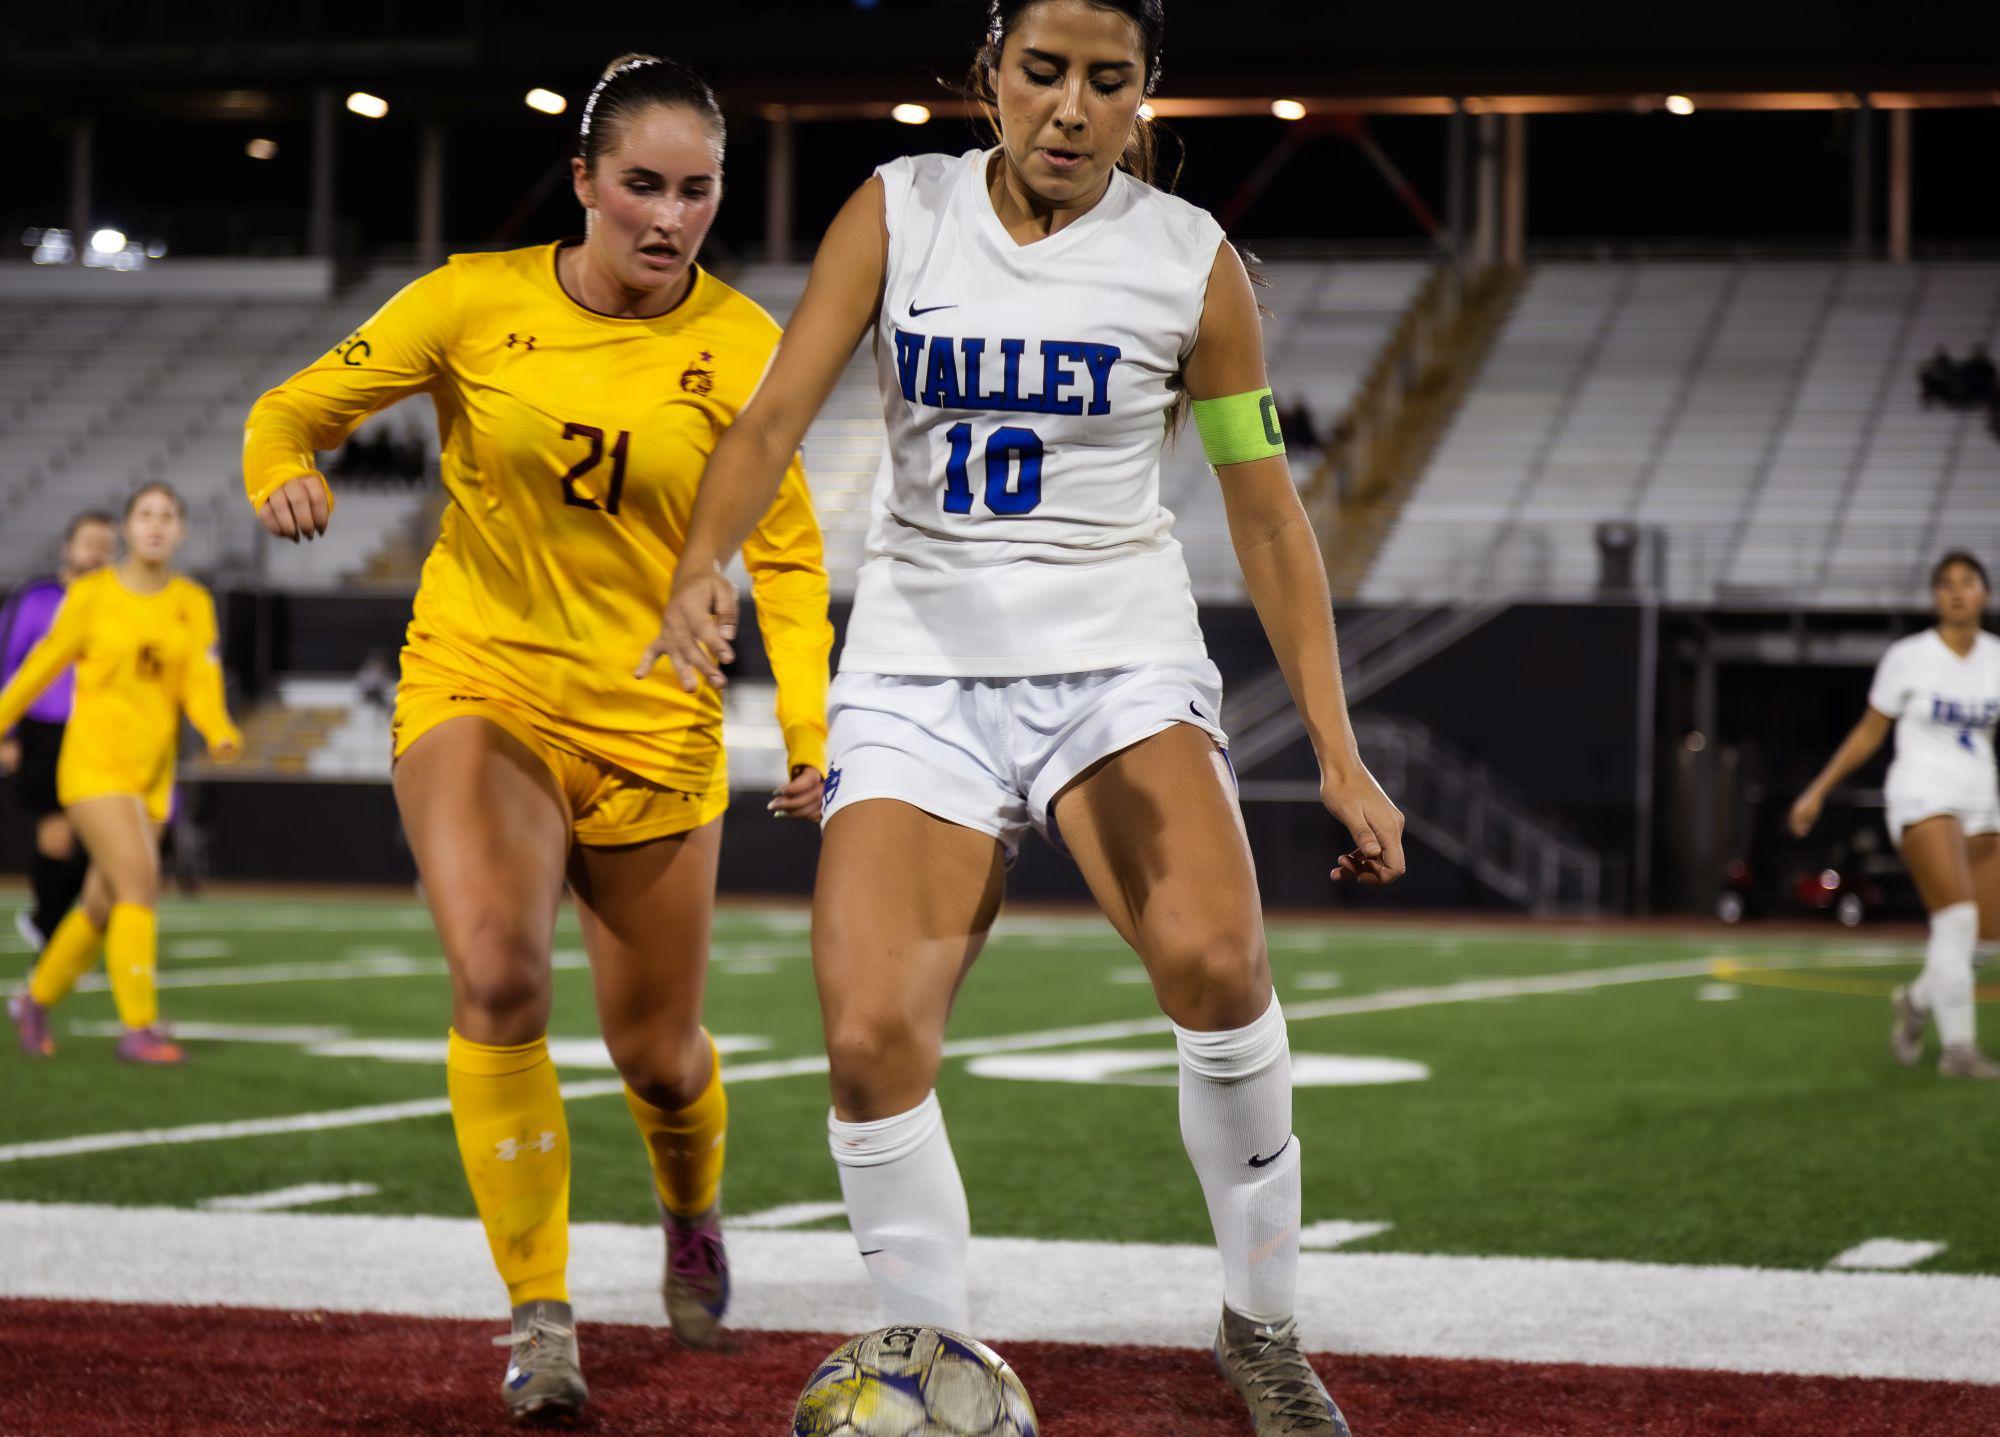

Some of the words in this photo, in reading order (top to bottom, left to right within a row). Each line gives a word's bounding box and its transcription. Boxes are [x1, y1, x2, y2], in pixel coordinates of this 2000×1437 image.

[894, 327, 1122, 417] VALLEY
[561, 422, 631, 516] 21
[942, 421, 1044, 516] 10
